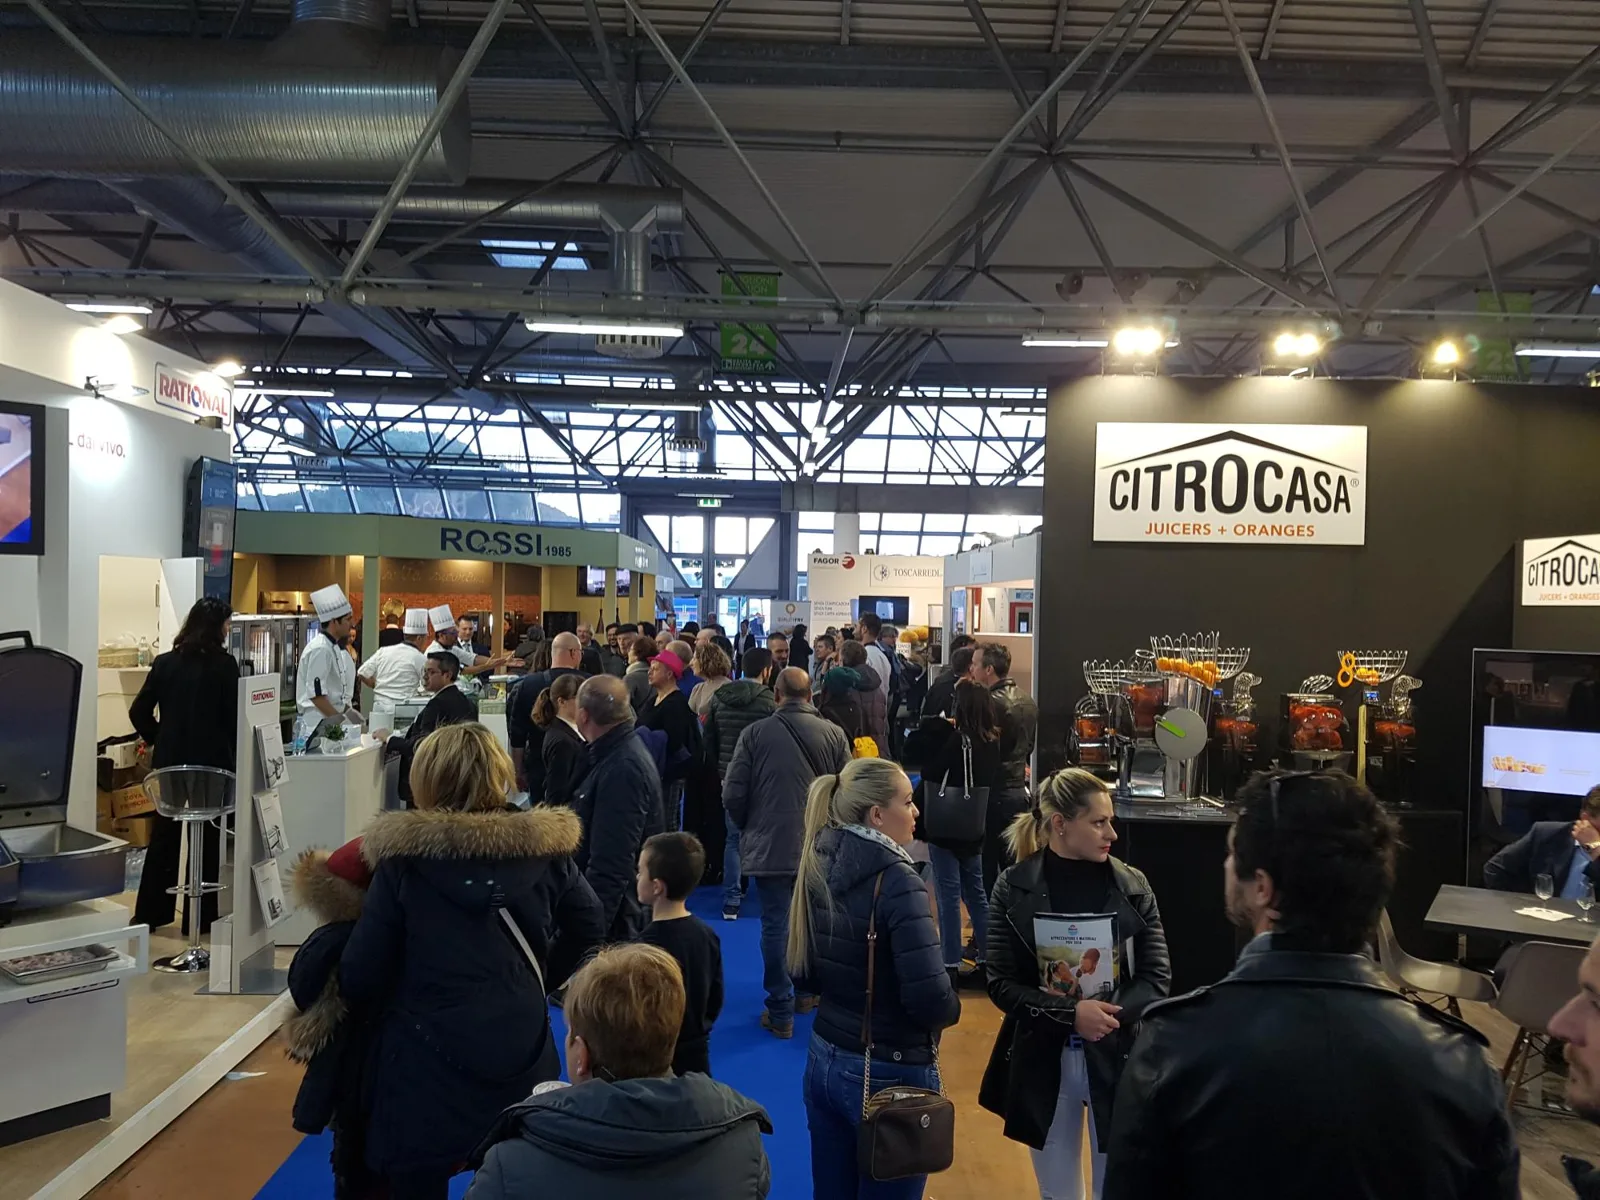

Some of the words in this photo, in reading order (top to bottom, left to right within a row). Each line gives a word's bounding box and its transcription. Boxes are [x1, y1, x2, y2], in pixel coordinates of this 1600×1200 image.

[159, 372, 228, 416] RATIONAL
[1145, 522, 1212, 537] JUICERS
[1233, 523, 1315, 538] ORANGES
[441, 527, 543, 556] ROSSI
[544, 546, 573, 558] 1985
[813, 557, 840, 565] FAGOR
